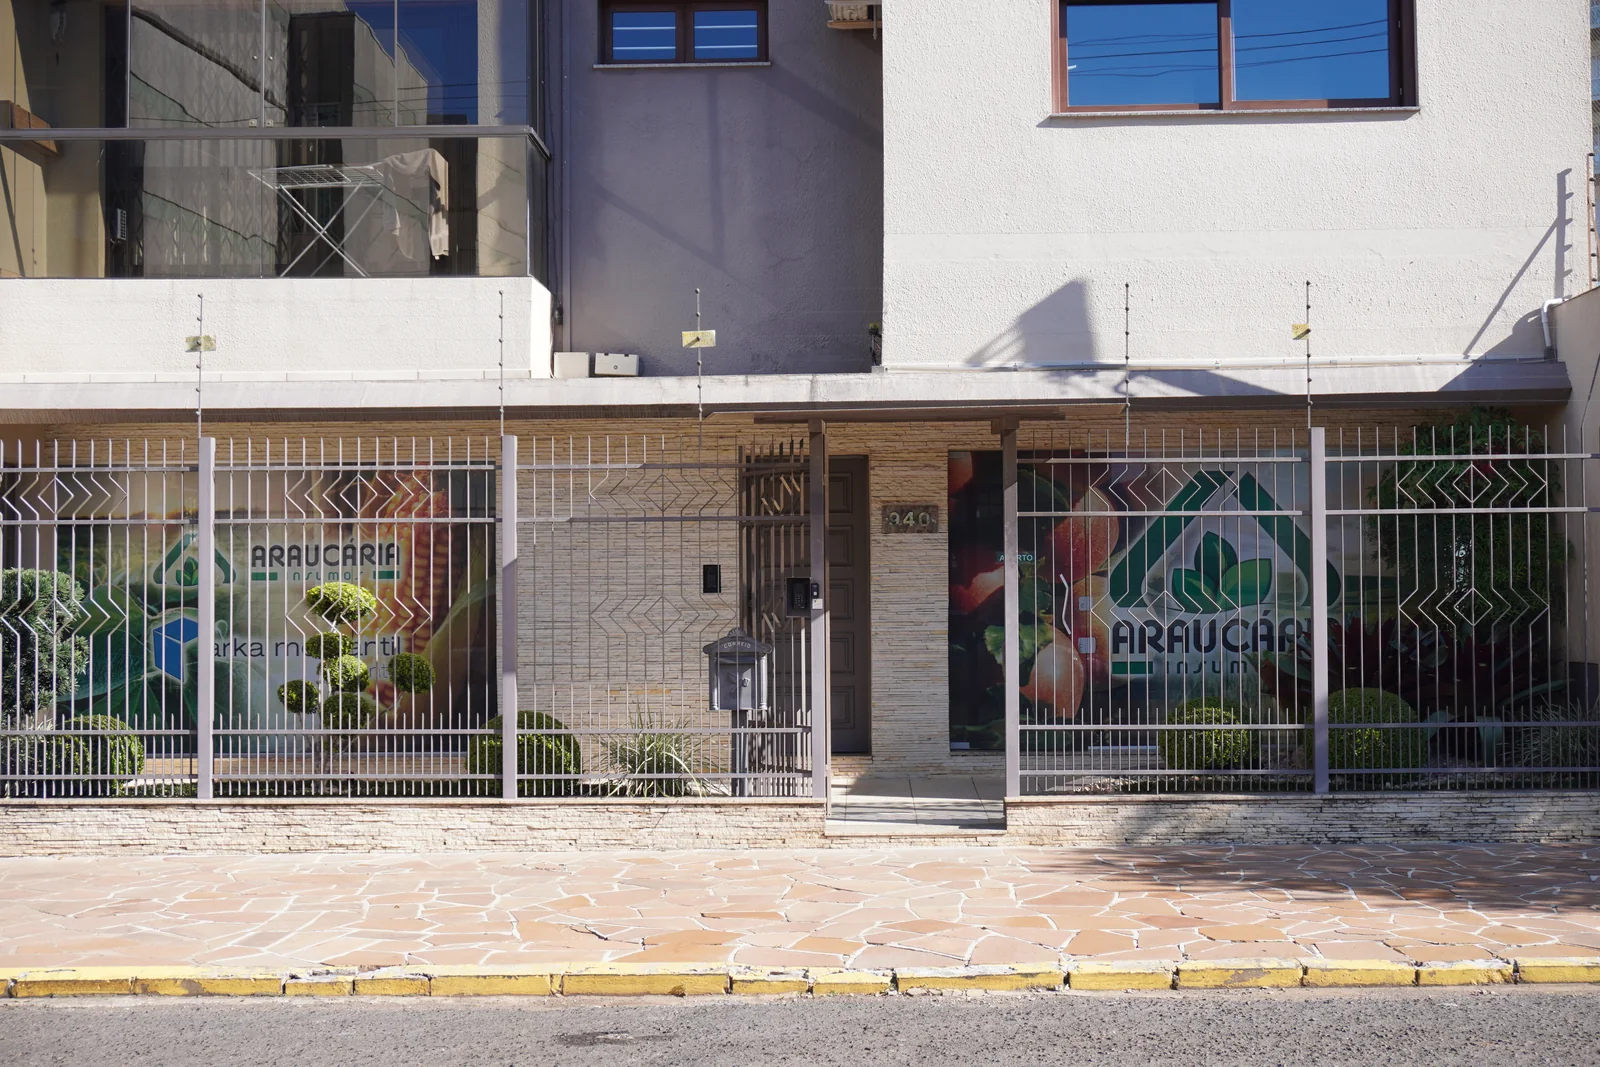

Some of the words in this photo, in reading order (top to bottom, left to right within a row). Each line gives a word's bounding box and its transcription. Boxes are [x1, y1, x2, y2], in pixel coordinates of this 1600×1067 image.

[889, 511, 930, 527] 940
[251, 537, 400, 568] ARAUCÁRIA
[999, 554, 1034, 562] ARTO
[1112, 609, 1341, 654] ARAUCÁR
[274, 636, 401, 658] mantil
